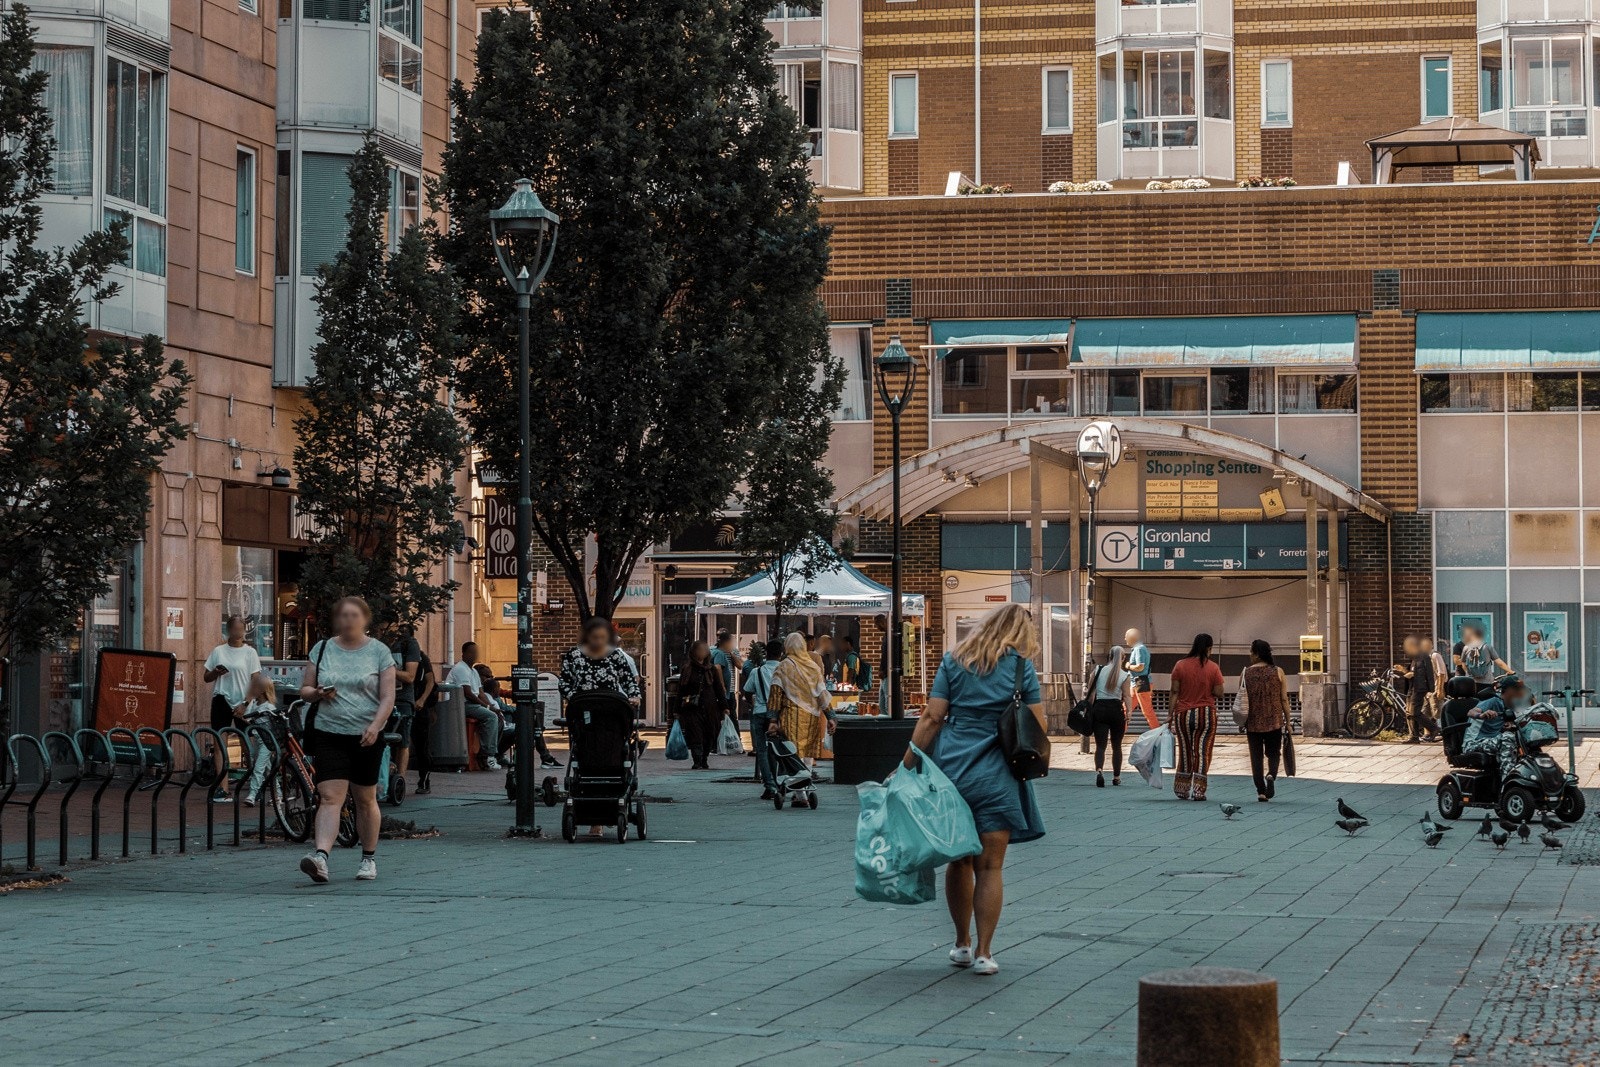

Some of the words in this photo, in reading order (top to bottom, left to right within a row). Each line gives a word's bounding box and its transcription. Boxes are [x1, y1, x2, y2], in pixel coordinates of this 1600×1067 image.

[1146, 460, 1214, 476] Shopping
[1218, 460, 1262, 474] Senter
[488, 498, 516, 526] Deli
[1144, 528, 1210, 542] Grønland
[1279, 548, 1329, 558] Forretnger
[486, 548, 518, 576] Luca
[626, 586, 650, 596] NLAND
[828, 600, 882, 608] Lycamobile
